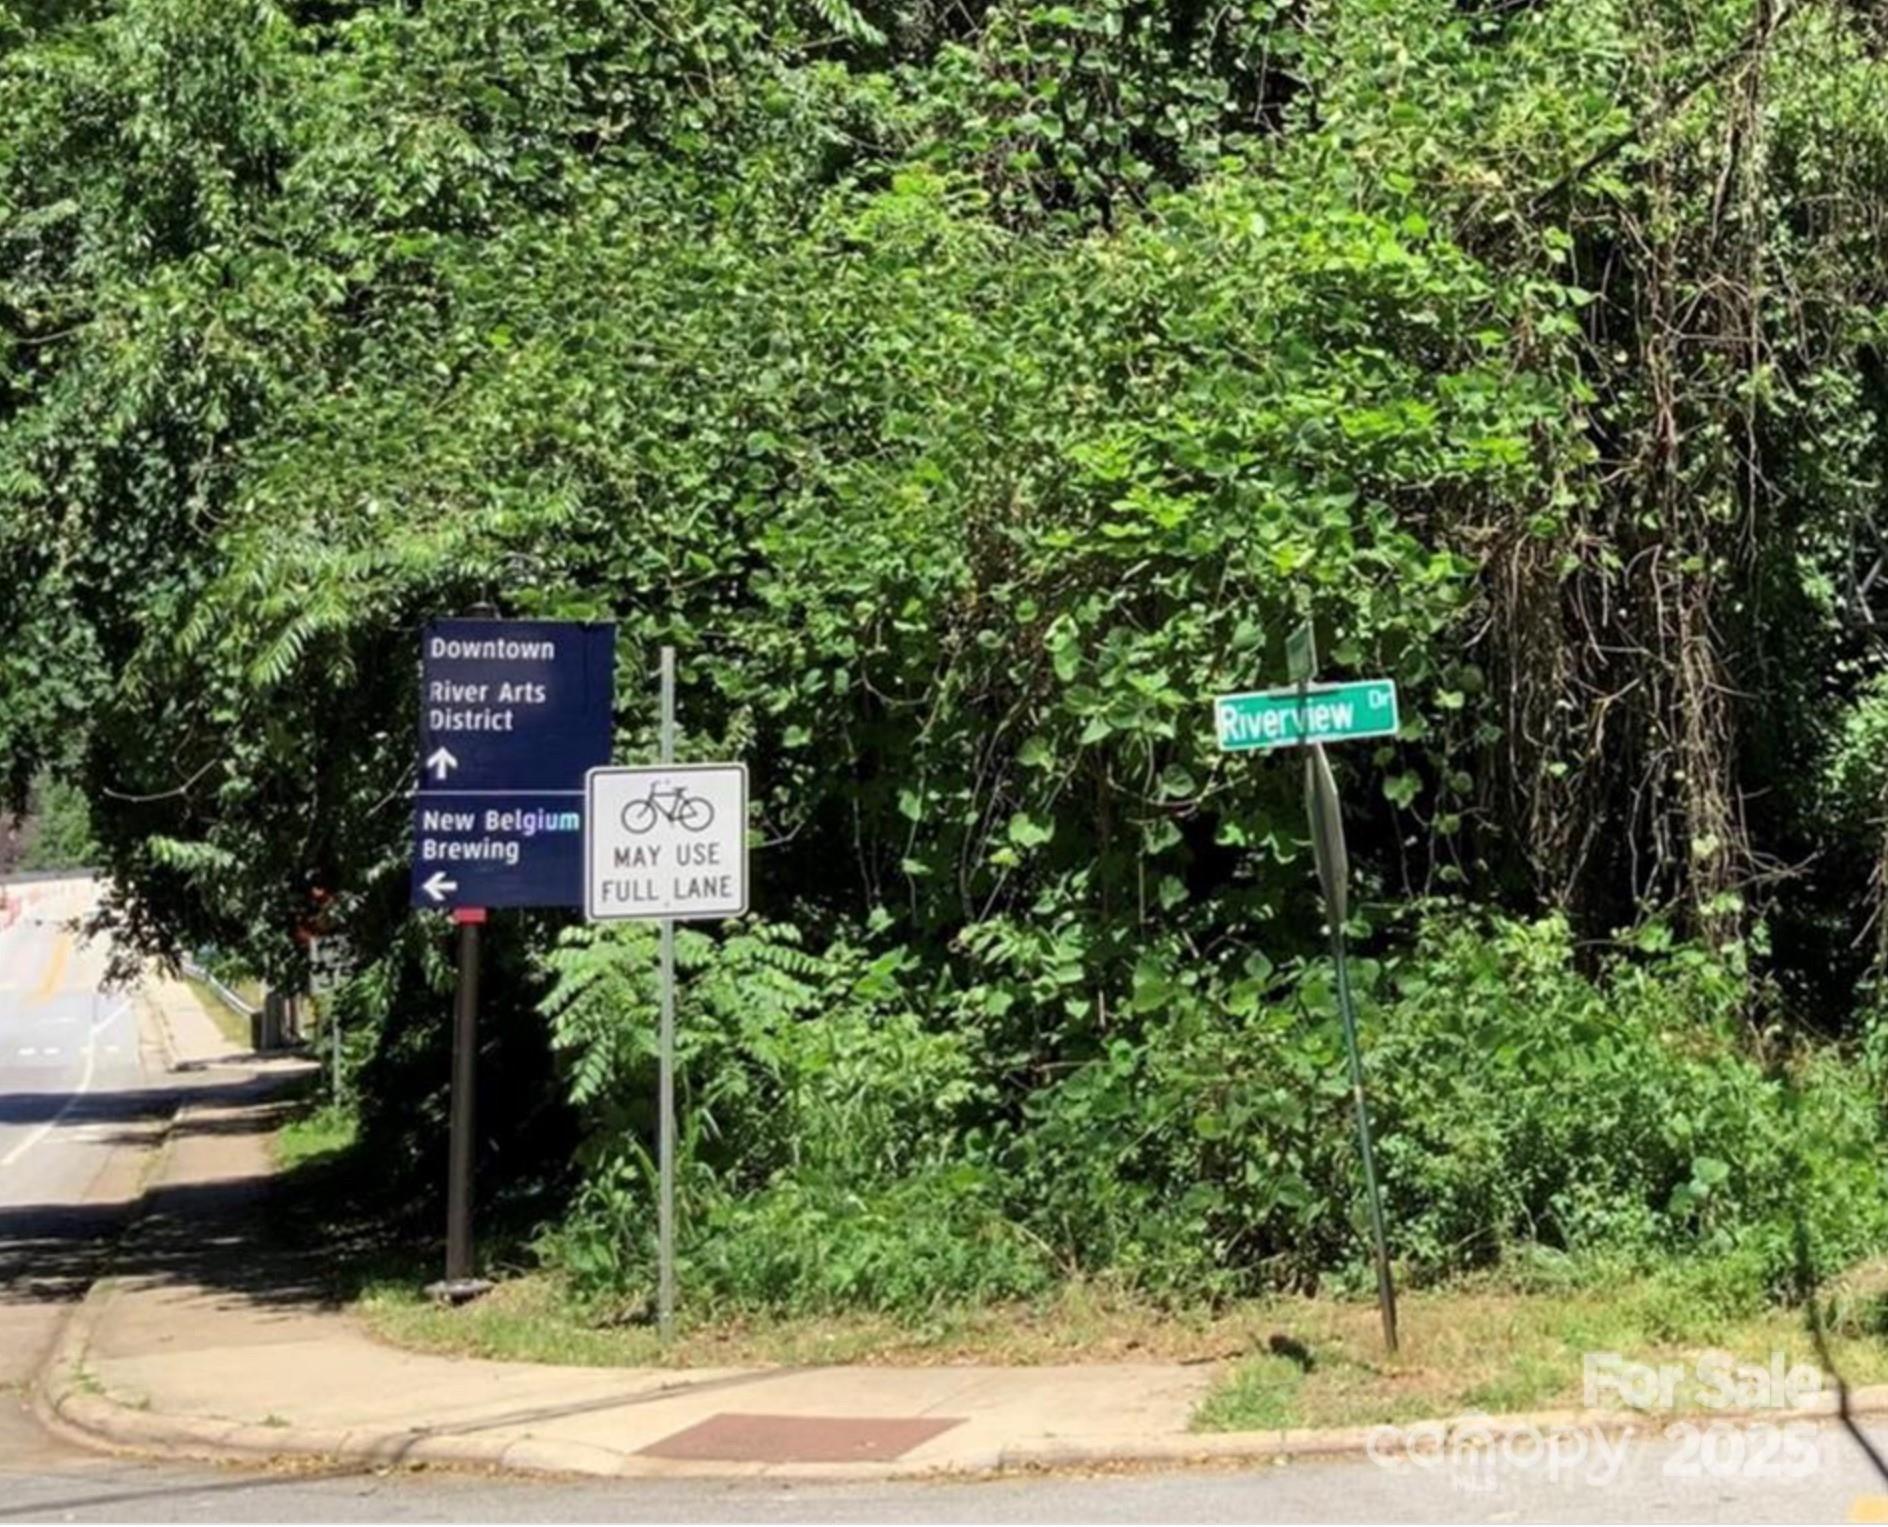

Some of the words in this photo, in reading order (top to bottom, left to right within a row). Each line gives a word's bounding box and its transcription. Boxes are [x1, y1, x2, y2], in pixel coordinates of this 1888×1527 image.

[430, 638, 555, 660] Downtown
[430, 681, 490, 703] River
[499, 682, 547, 704] Arts
[430, 709, 515, 731] District
[1221, 698, 1353, 740] Riverview
[1369, 690, 1390, 709] Dr
[422, 810, 473, 832] New
[485, 809, 581, 837] Belgium
[422, 838, 520, 864] Brewing
[613, 845, 663, 868] MAY
[676, 842, 721, 866] USE
[601, 880, 660, 904] FULL
[673, 876, 732, 901] LANE
